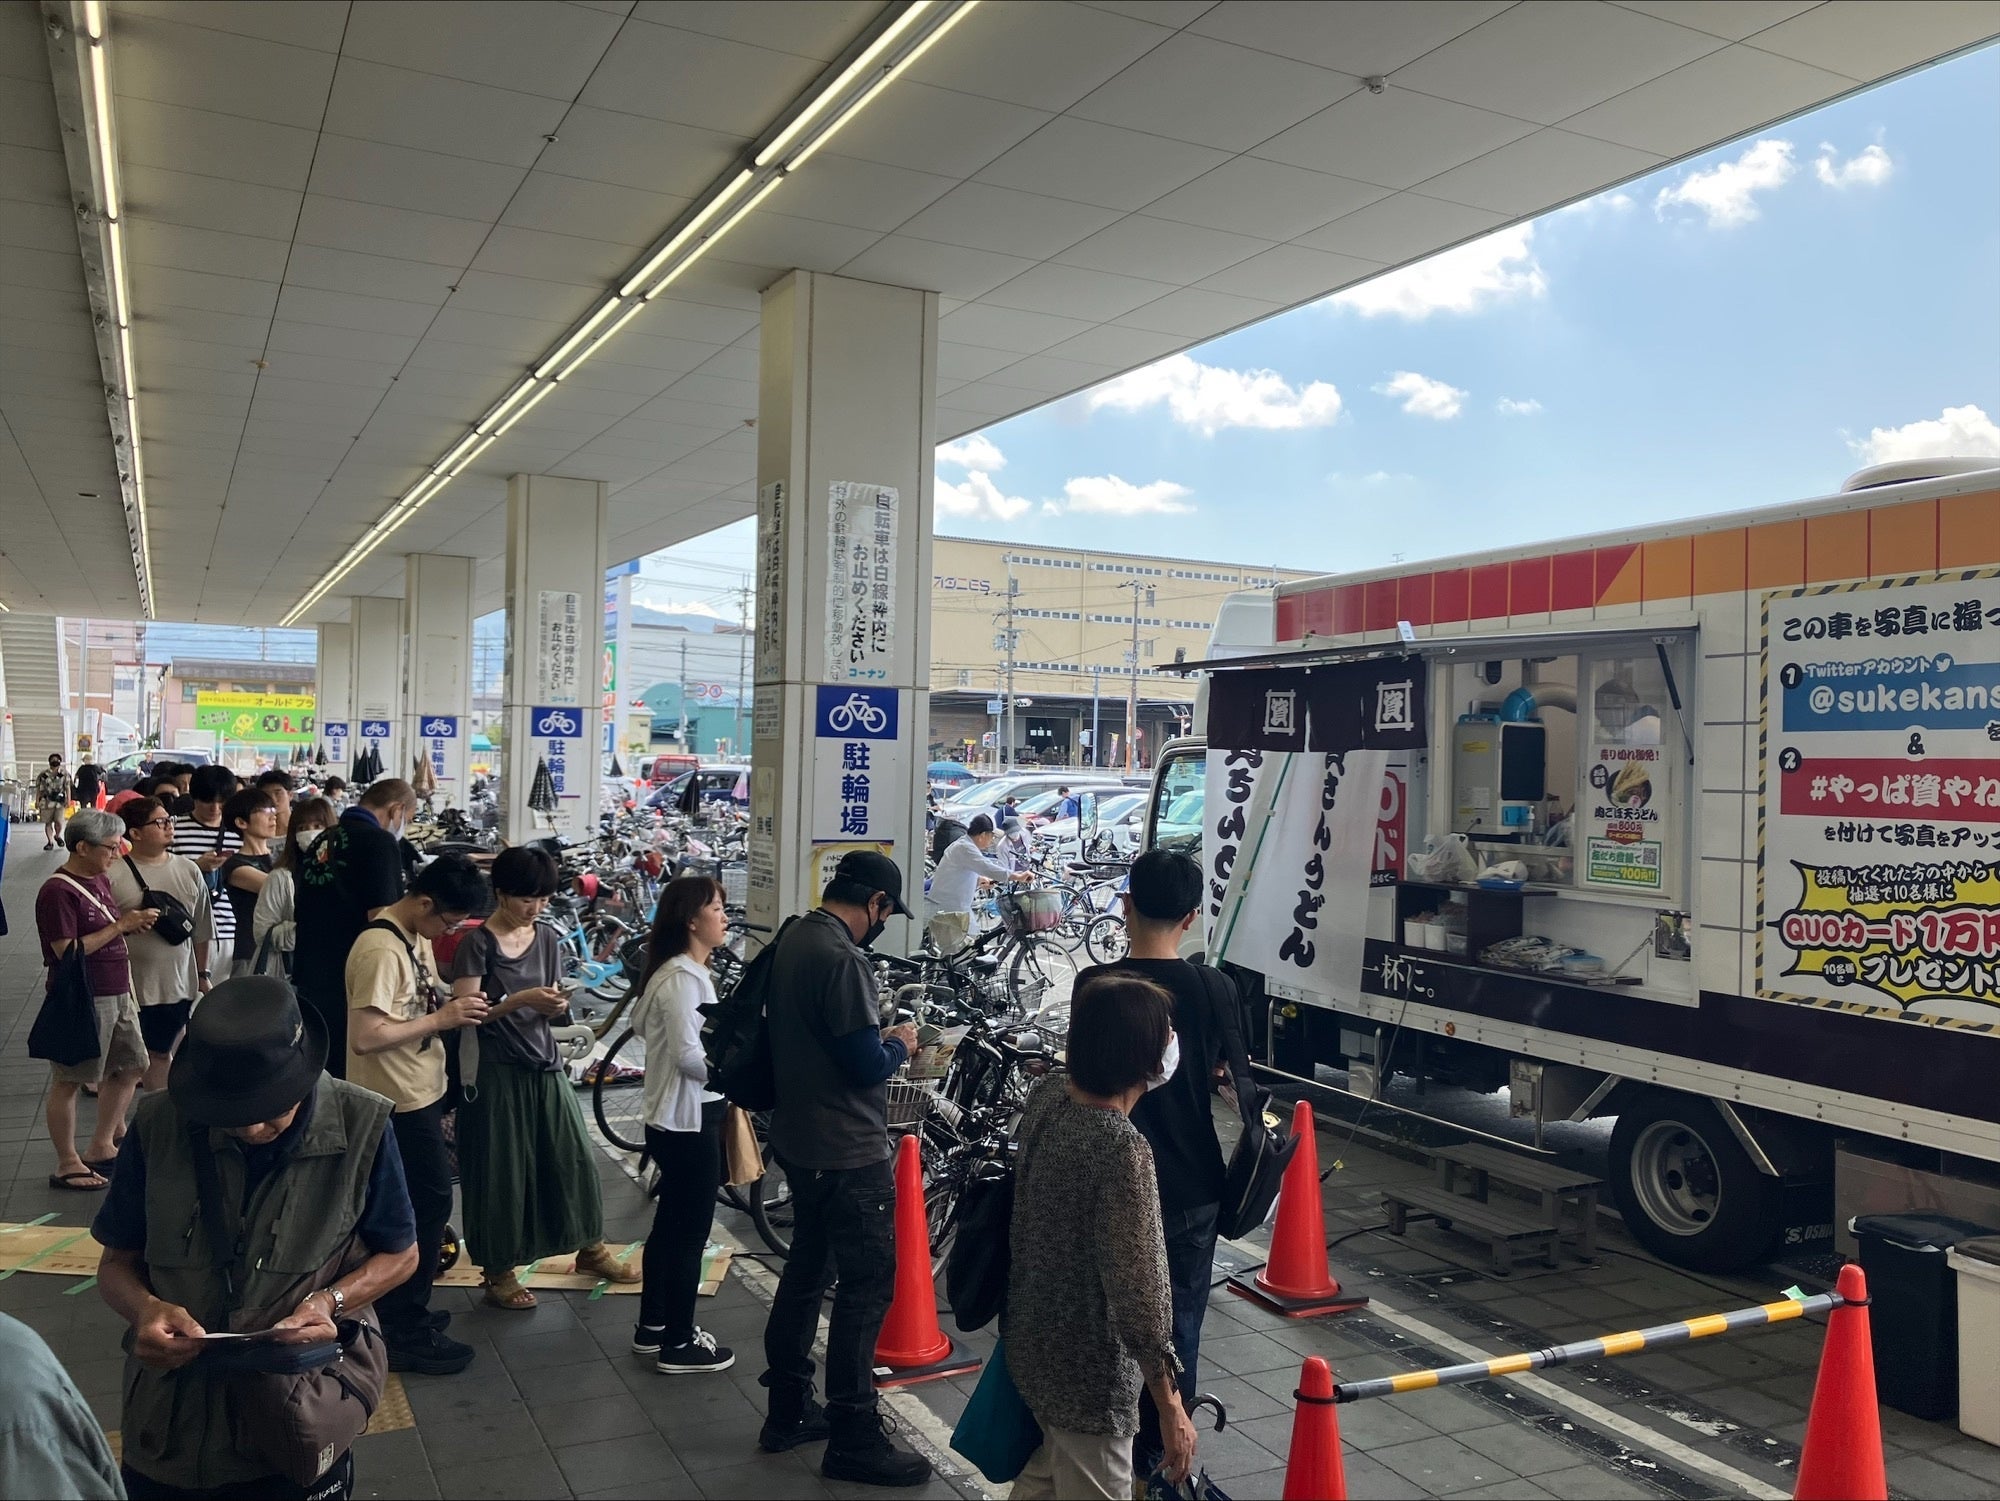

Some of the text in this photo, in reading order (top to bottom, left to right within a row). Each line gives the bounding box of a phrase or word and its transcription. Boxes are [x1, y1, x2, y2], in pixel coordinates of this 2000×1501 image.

[871, 493, 891, 653] 自転車は白線枠内に
[849, 543, 868, 663] お止めください
[848, 668, 887, 679] コーナン
[1805, 656, 1930, 677] Twitterアカウント
[255, 698, 292, 707] オールド
[1907, 732, 1925, 755] &
[840, 742, 871, 836] 駐輪場
[1816, 862, 1988, 885] 投稿してくれた方の中から
[1849, 884, 1954, 903] 抽選で10名様に
